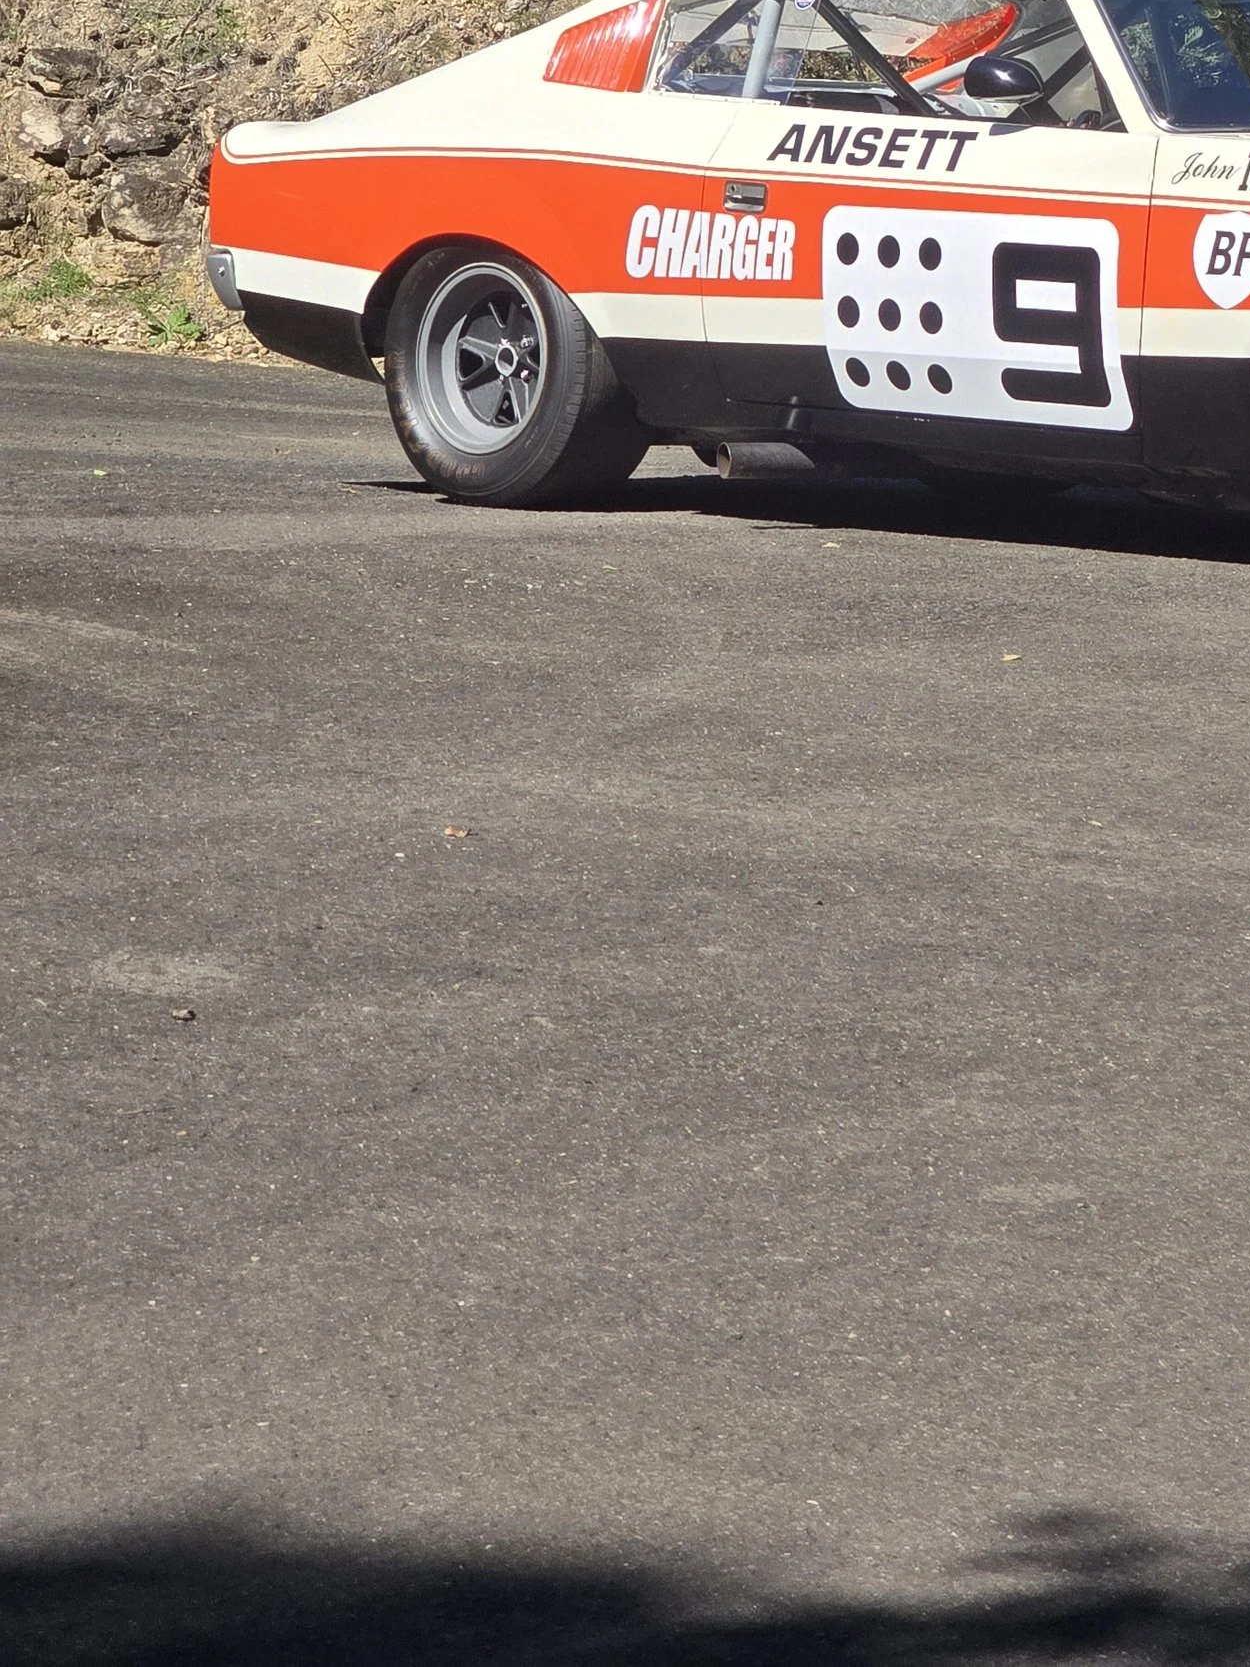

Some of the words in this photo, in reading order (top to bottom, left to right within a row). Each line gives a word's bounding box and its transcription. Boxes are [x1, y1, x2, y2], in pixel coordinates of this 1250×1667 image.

[766, 123, 979, 172] ANSETT
[1171, 152, 1241, 185] John
[625, 204, 796, 281] CHARGER
[992, 241, 1112, 408] 9
